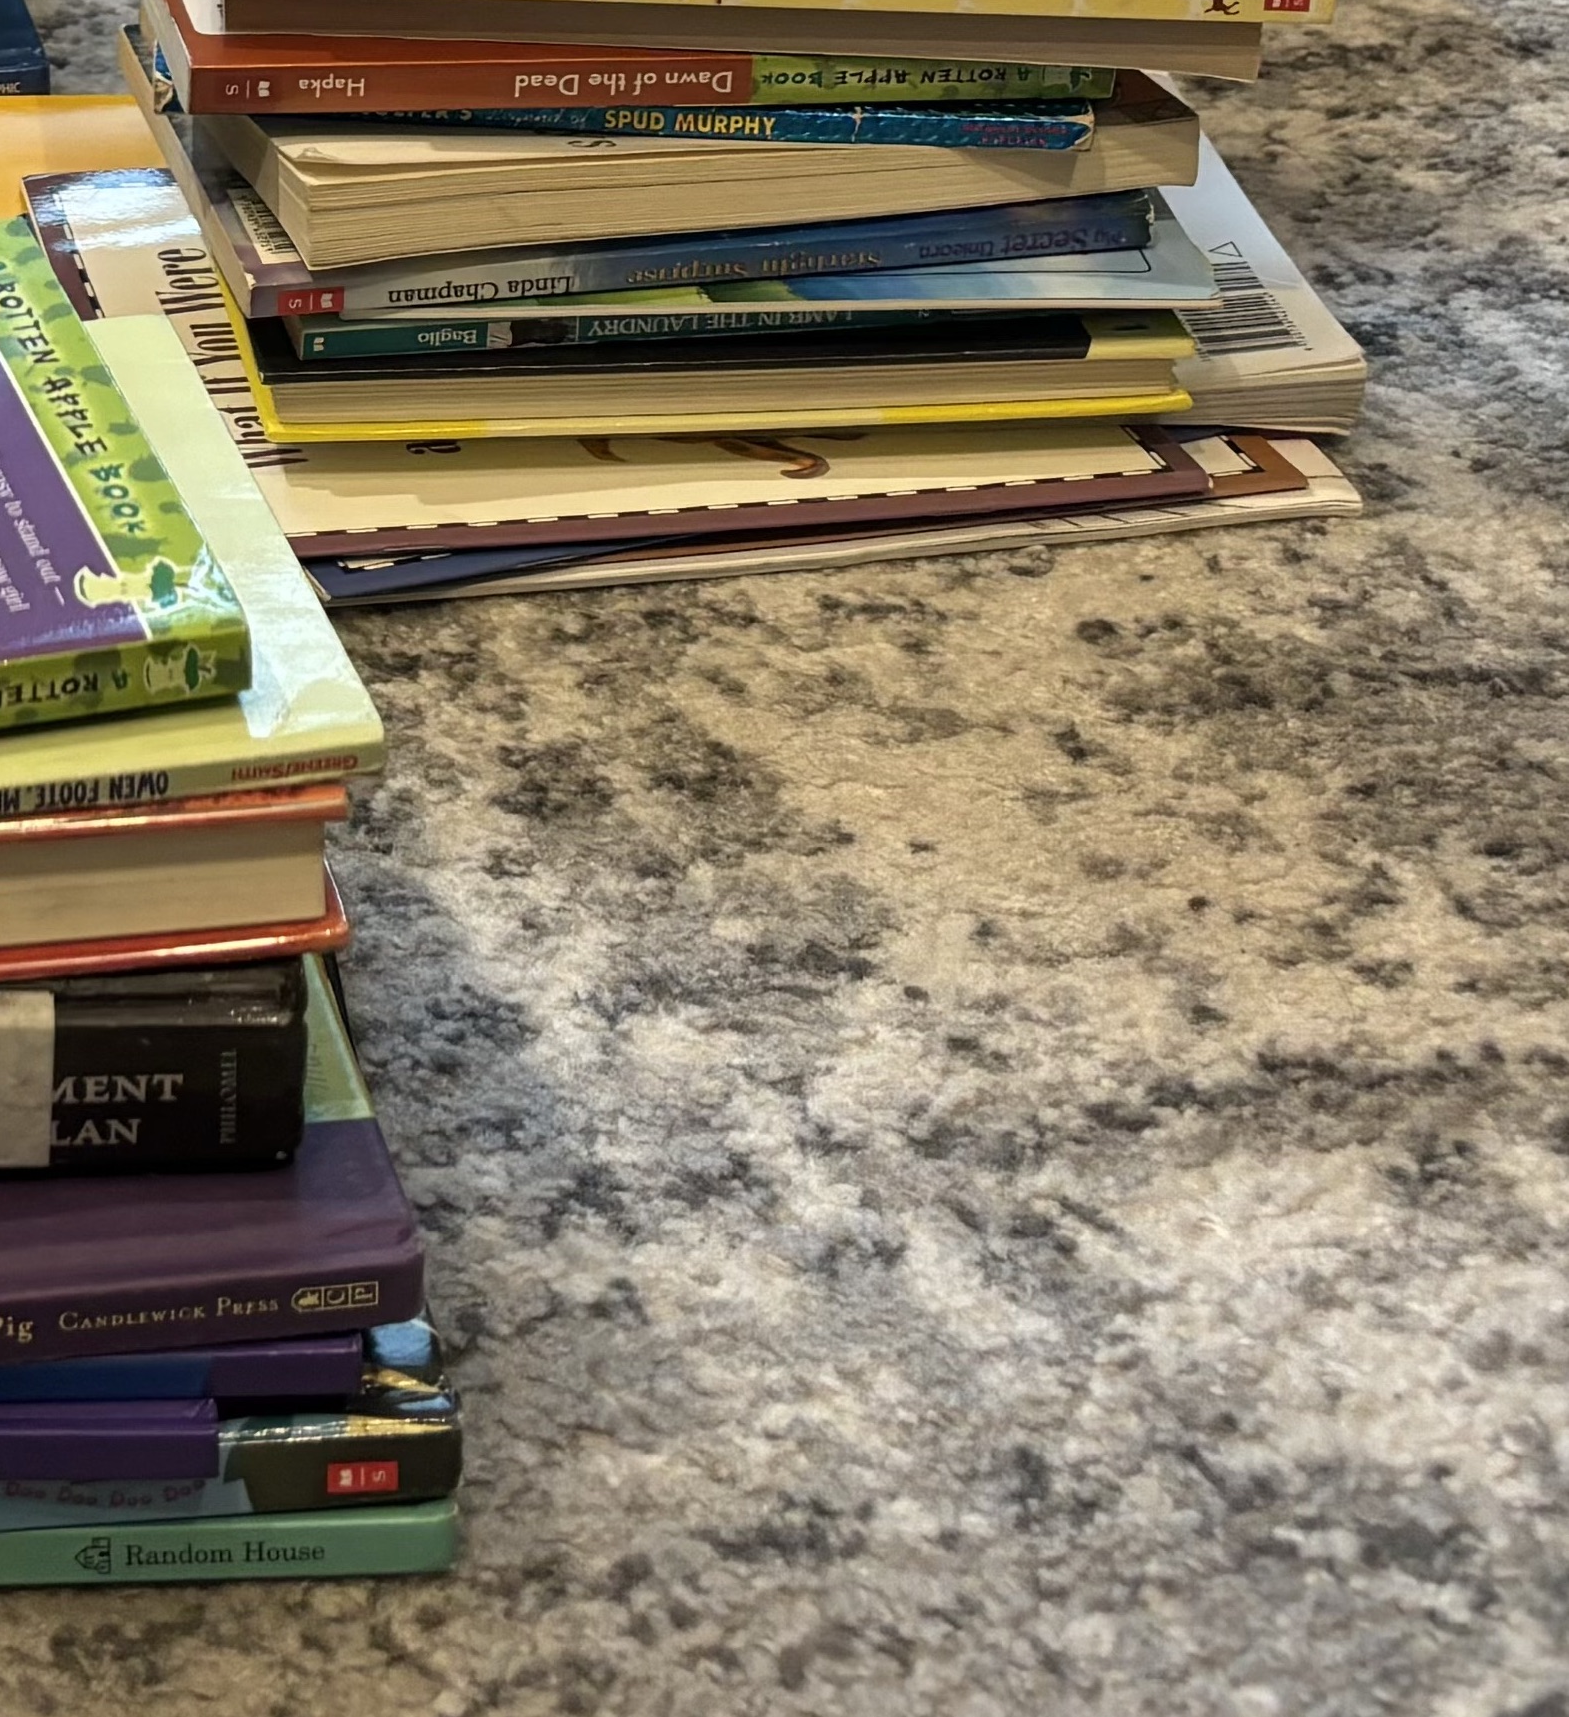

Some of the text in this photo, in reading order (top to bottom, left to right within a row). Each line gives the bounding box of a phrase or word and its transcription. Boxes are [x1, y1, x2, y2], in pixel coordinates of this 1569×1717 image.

[298, 76, 366, 99] Hapka
[513, 69, 735, 99] Dawn of the Dead
[603, 110, 776, 138] SPUD MURPHY
[387, 273, 575, 308] Linda Chapman
[125, 1538, 326, 1568] Random House
